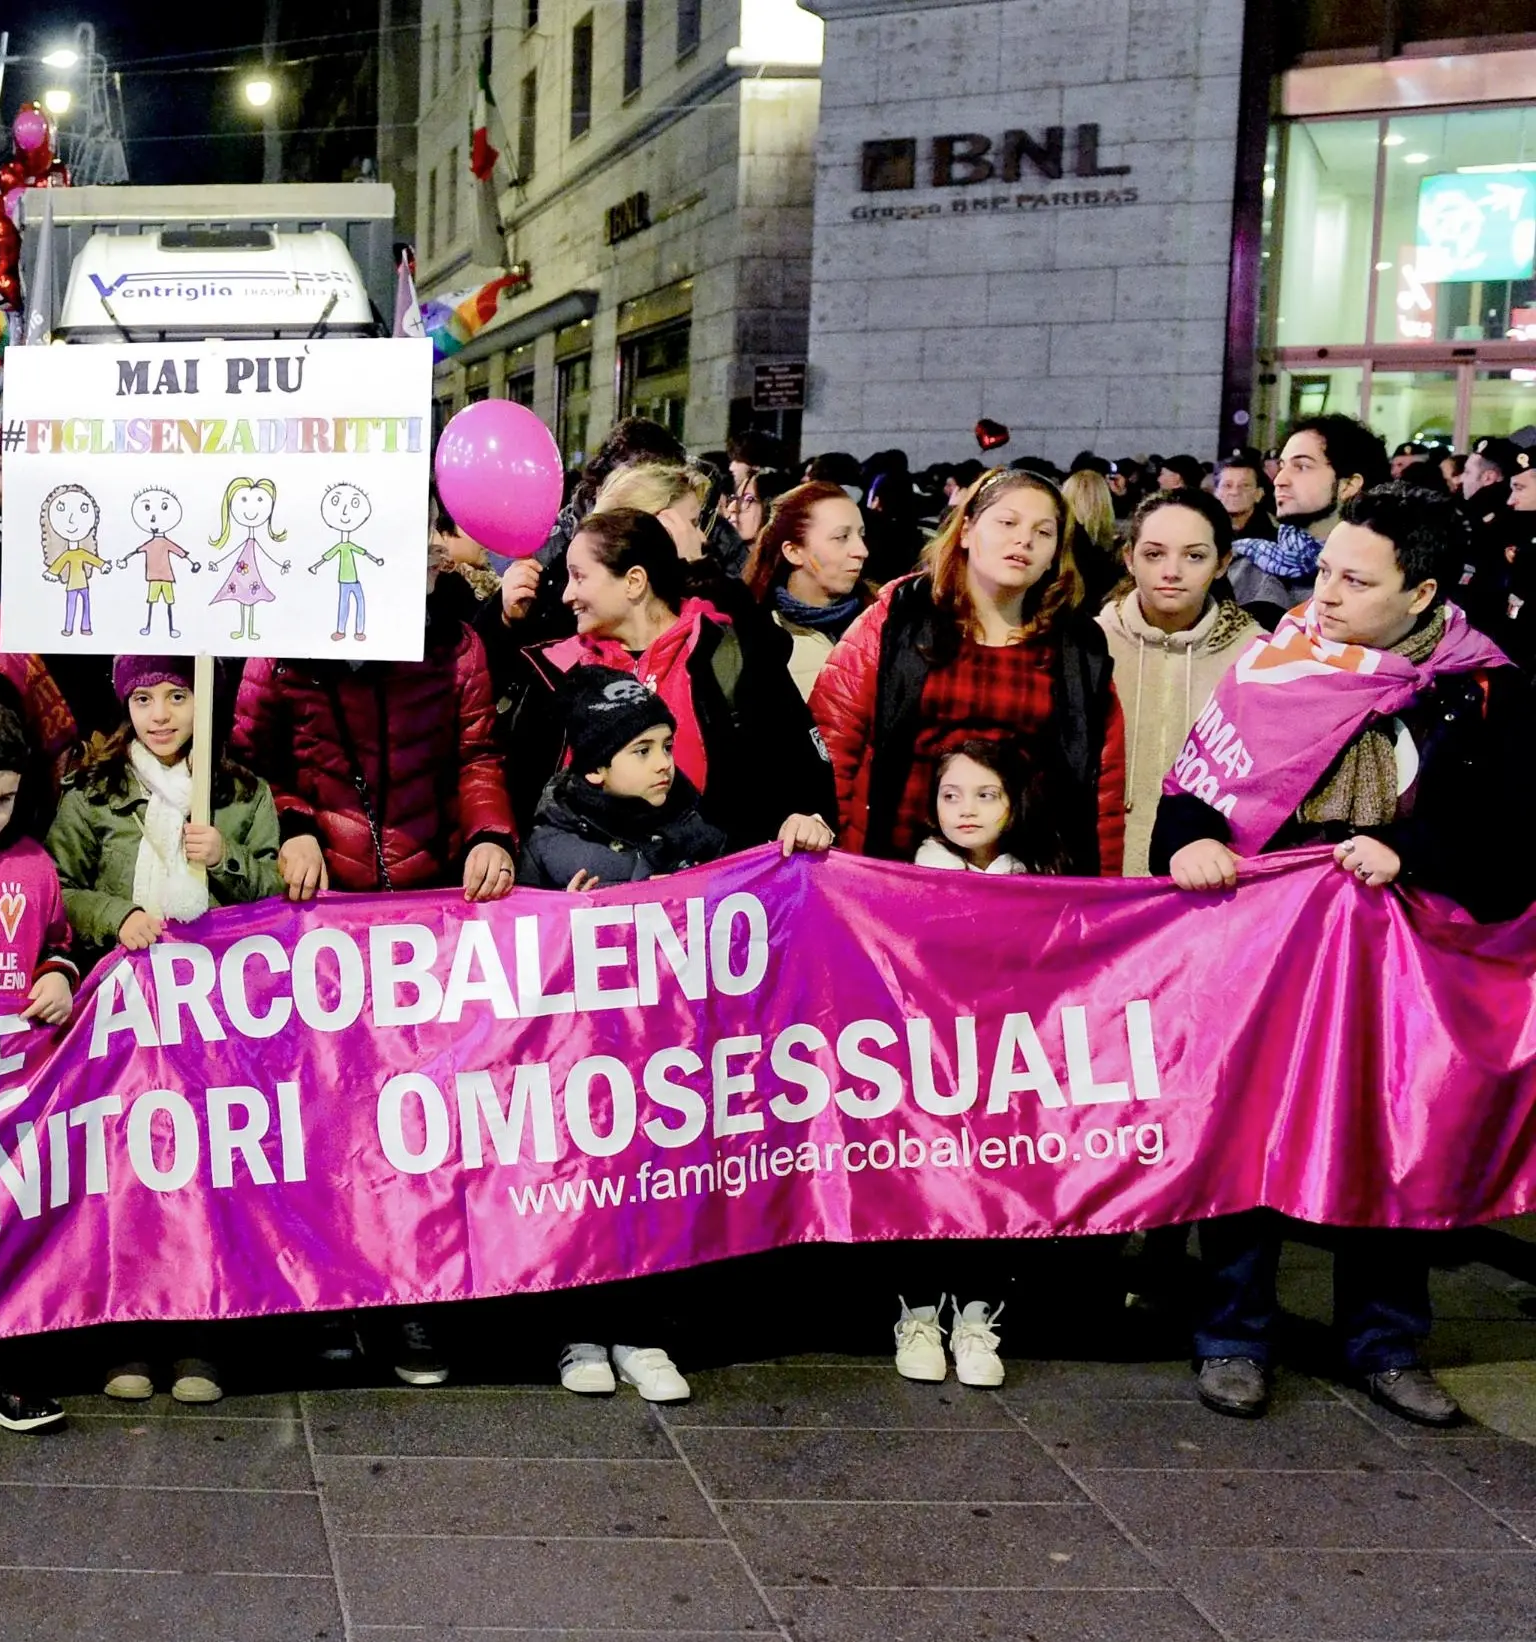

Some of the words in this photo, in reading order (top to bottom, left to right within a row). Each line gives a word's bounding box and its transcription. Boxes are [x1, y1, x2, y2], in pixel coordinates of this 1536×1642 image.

[931, 123, 1131, 187] BNL
[851, 203, 941, 220] Gruppo
[951, 199, 1010, 213] BNP
[1016, 187, 1139, 208] PARIBAS
[88, 274, 233, 301] Ventriglia
[115, 359, 200, 396] MAI
[2, 417, 424, 454] #FIGLISENZADIRITTI
[87, 892, 768, 1059] ARCOBALENO
[377, 1000, 1161, 1175] OMOSESSUALI
[509, 1119, 1164, 1215] www.famigliearcobaleno.org
